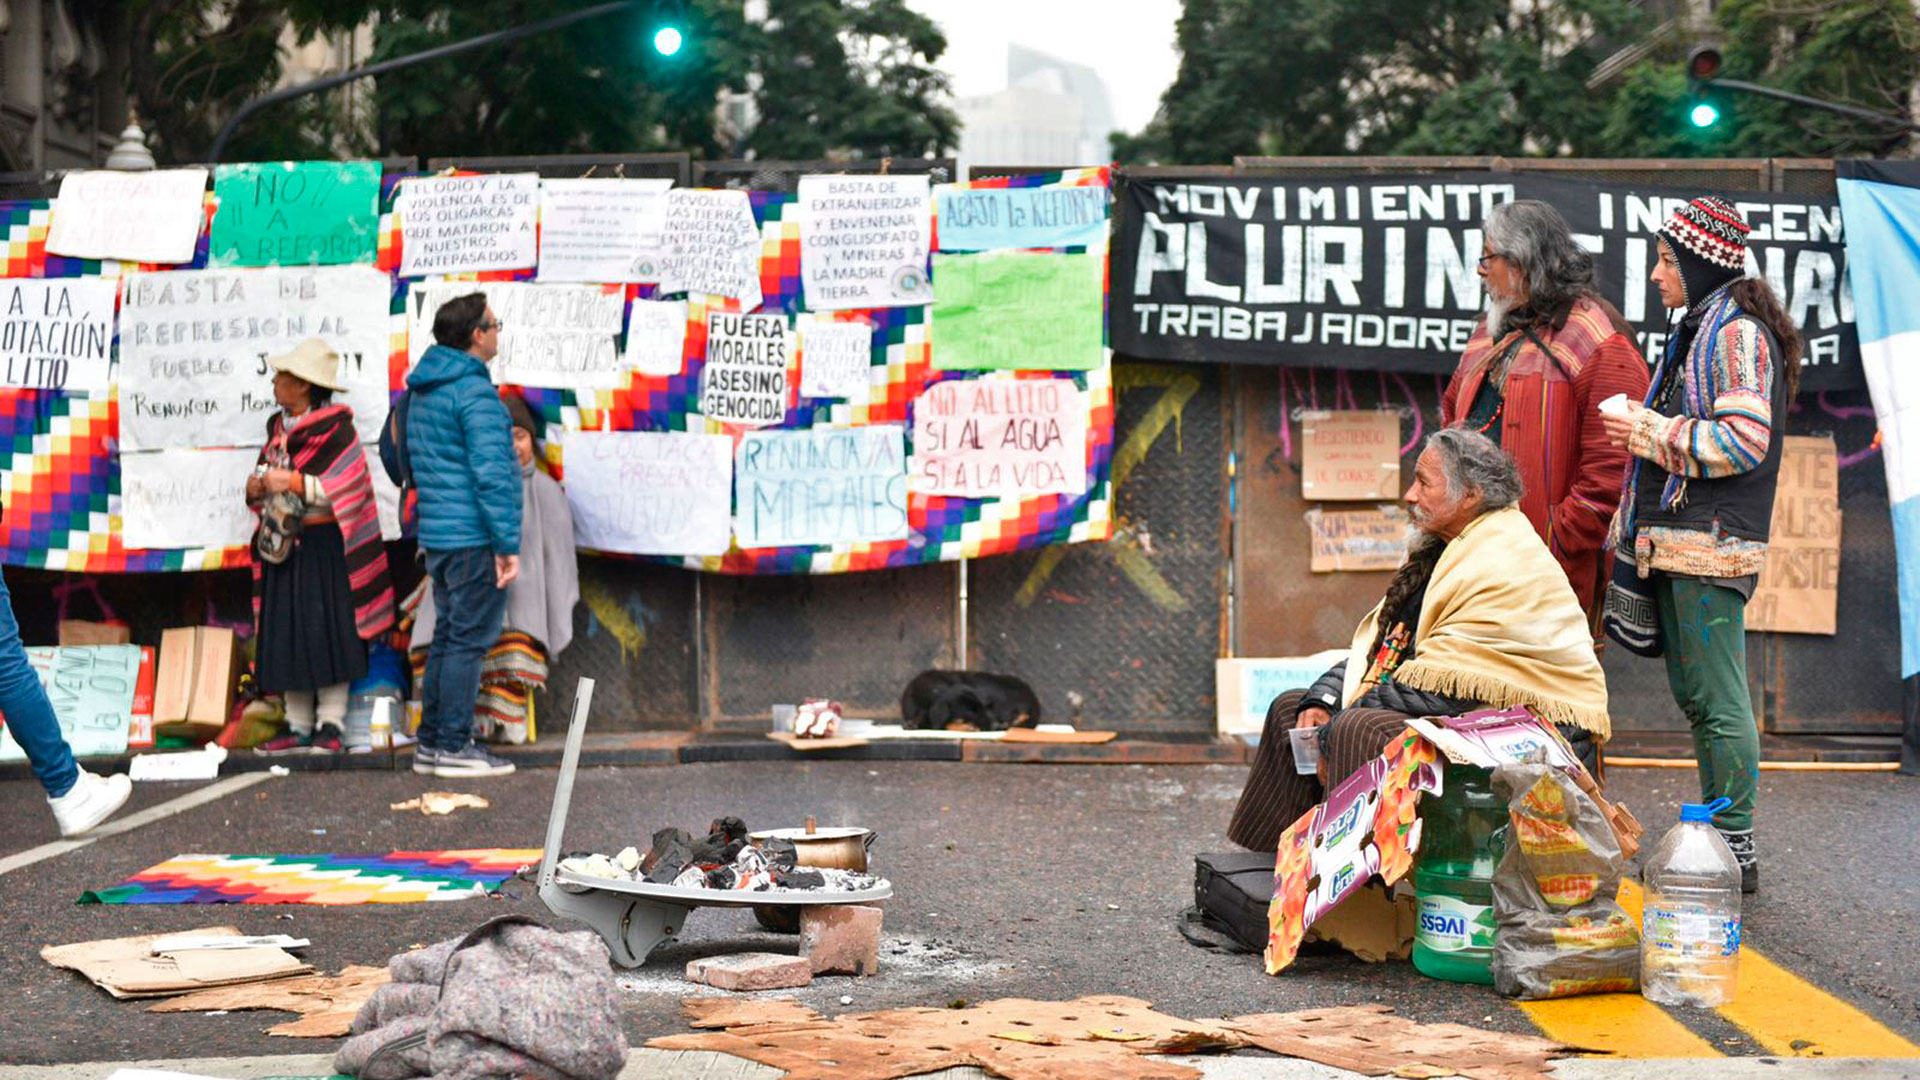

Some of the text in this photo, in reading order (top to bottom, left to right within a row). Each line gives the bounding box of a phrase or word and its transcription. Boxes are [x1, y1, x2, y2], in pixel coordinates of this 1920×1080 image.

[433, 183, 474, 193] ODIO
[477, 180, 489, 191] Y
[498, 180, 517, 190] LA
[829, 182, 897, 193] BASTA DE
[410, 196, 483, 209] VIOLENCIA
[491, 194, 508, 205] ES
[513, 193, 532, 205] DE
[811, 198, 922, 211] EXTRANJERIZAR
[1153, 183, 1515, 221] MOVIMIENTO
[405, 207, 516, 223] LOS OLIGARCAS
[666, 208, 691, 220] LAS
[815, 216, 917, 230] Y ENVENENAR
[405, 222, 530, 239] QUE MATARON A
[258, 232, 380, 260] REFORMA
[423, 236, 498, 252] NUESTROS
[413, 250, 519, 269] ANTEPASADOS
[824, 249, 923, 265] Y MINERAS A
[812, 267, 887, 281] LA MADRE
[278, 279, 317, 298] DE
[819, 289, 869, 298] TIERRA
[9, 286, 73, 317] A LA
[1, 311, 107, 359] OTACIÓN
[710, 316, 784, 338] FUERA
[1133, 303, 1479, 352] TRABAJADORE
[707, 340, 786, 367] MORALES
[6, 357, 69, 387] LITIO
[149, 357, 235, 377] PUEBLO
[707, 372, 784, 394] ASESINO
[706, 394, 783, 420] GENOCIDA
[930, 388, 957, 415] NO
[973, 386, 1001, 412] AL
[926, 419, 1064, 452] SI AL AGUA
[744, 437, 864, 471] RENUNCIA
[924, 465, 948, 490] SI
[972, 464, 1001, 487] LA
[1012, 460, 1066, 489] VIDA
[753, 474, 906, 541] MORALES
